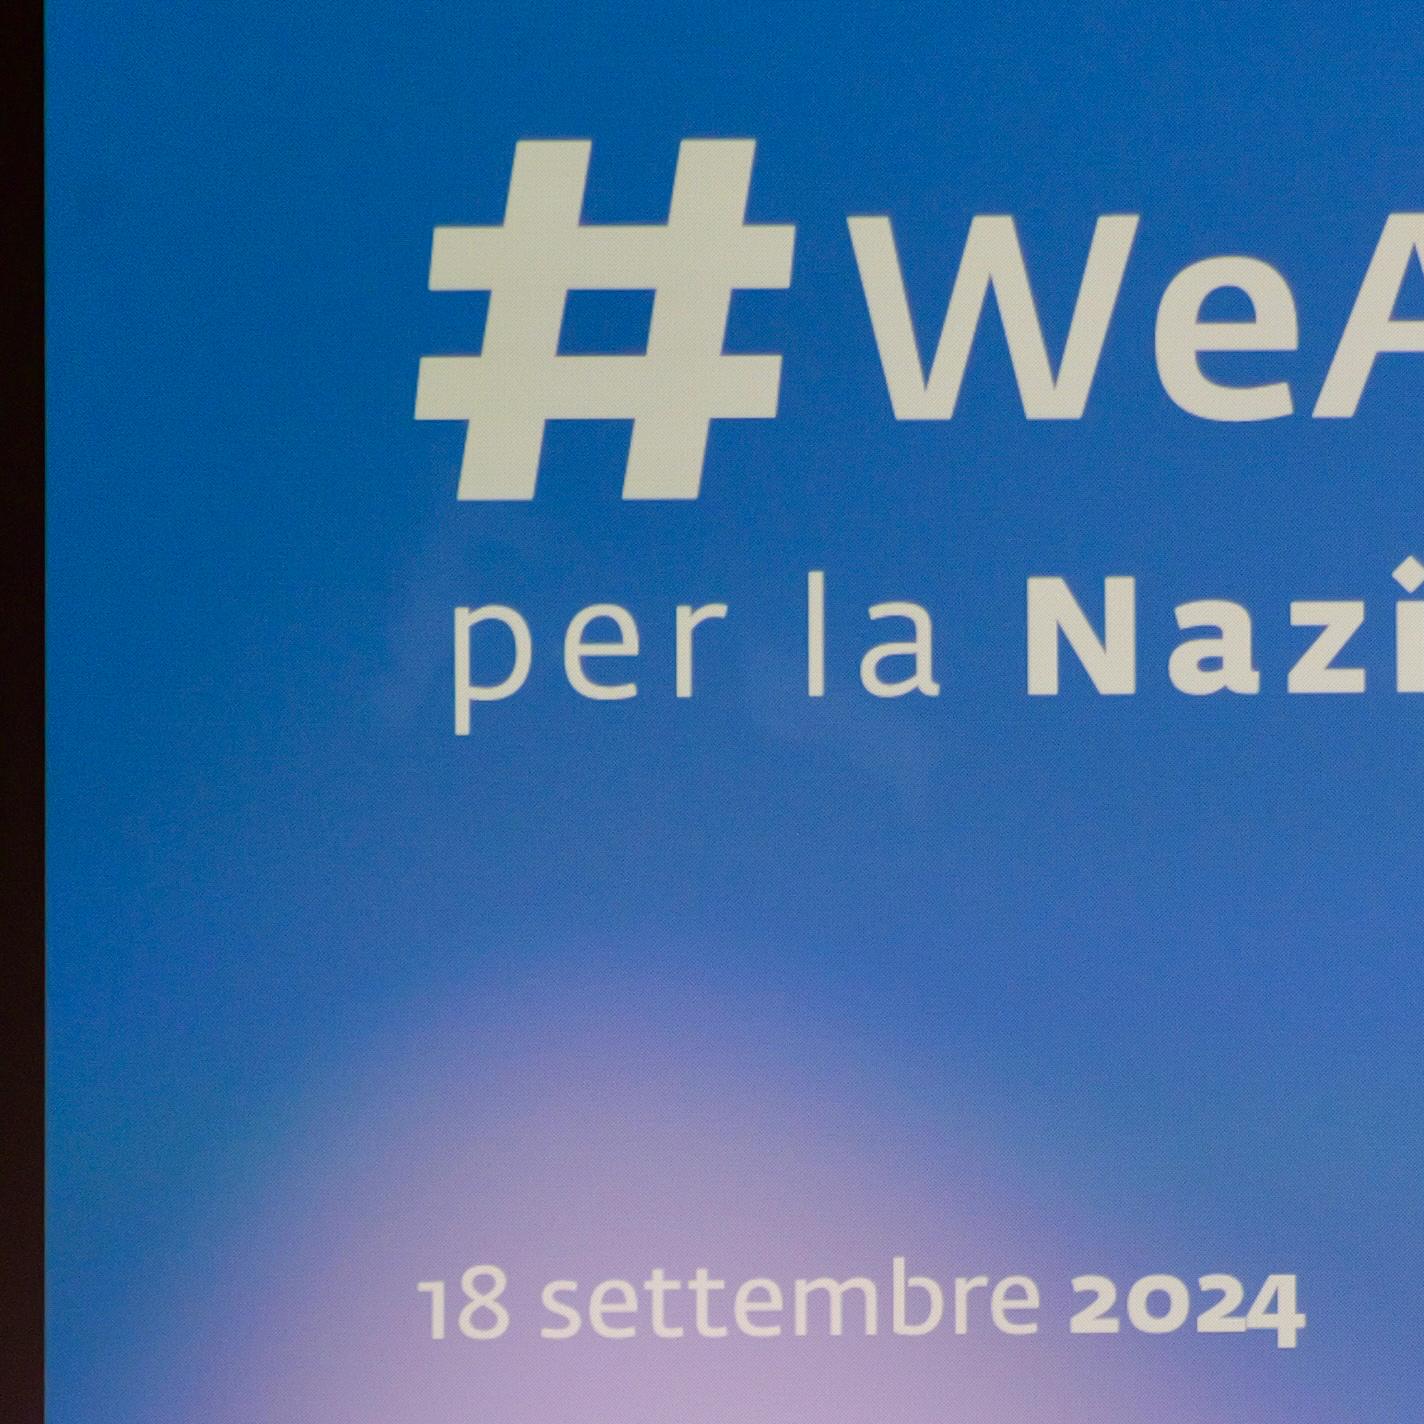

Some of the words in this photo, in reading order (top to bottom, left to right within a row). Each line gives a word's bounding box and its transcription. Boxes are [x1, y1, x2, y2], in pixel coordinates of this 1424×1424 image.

[452, 603, 728, 738] per
[807, 569, 941, 700] la
[417, 1264, 511, 1340] 18
[540, 1256, 1041, 1339] settembre
[1069, 1273, 1308, 1350] 2024
